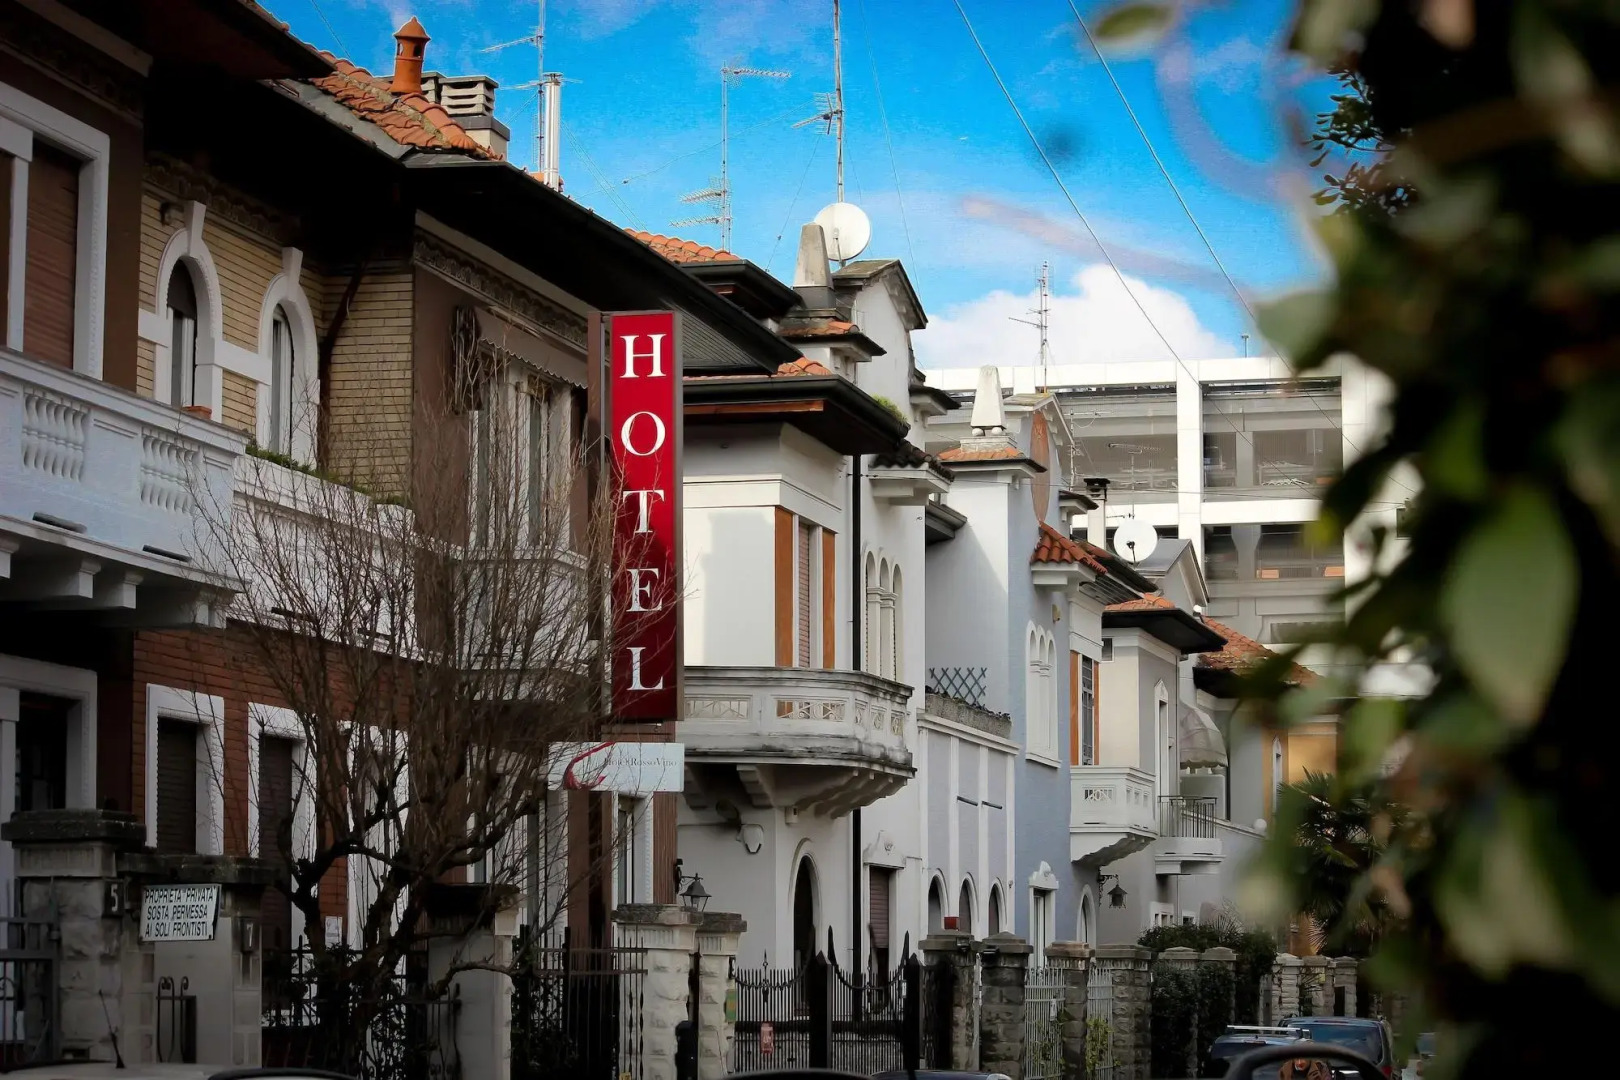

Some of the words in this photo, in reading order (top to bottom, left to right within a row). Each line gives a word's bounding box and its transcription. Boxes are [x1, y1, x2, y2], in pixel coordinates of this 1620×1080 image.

[619, 333, 667, 691] HOTEL
[110, 883, 118, 912] 5
[185, 887, 214, 902] PRIVATA
[147, 905, 169, 920] SOSTA
[172, 904, 208, 920] PERMESSA
[145, 922, 153, 937] AI
[155, 922, 170, 937] SOLI
[172, 921, 208, 937] FRONTISTI
[246, 922, 254, 947] 7
